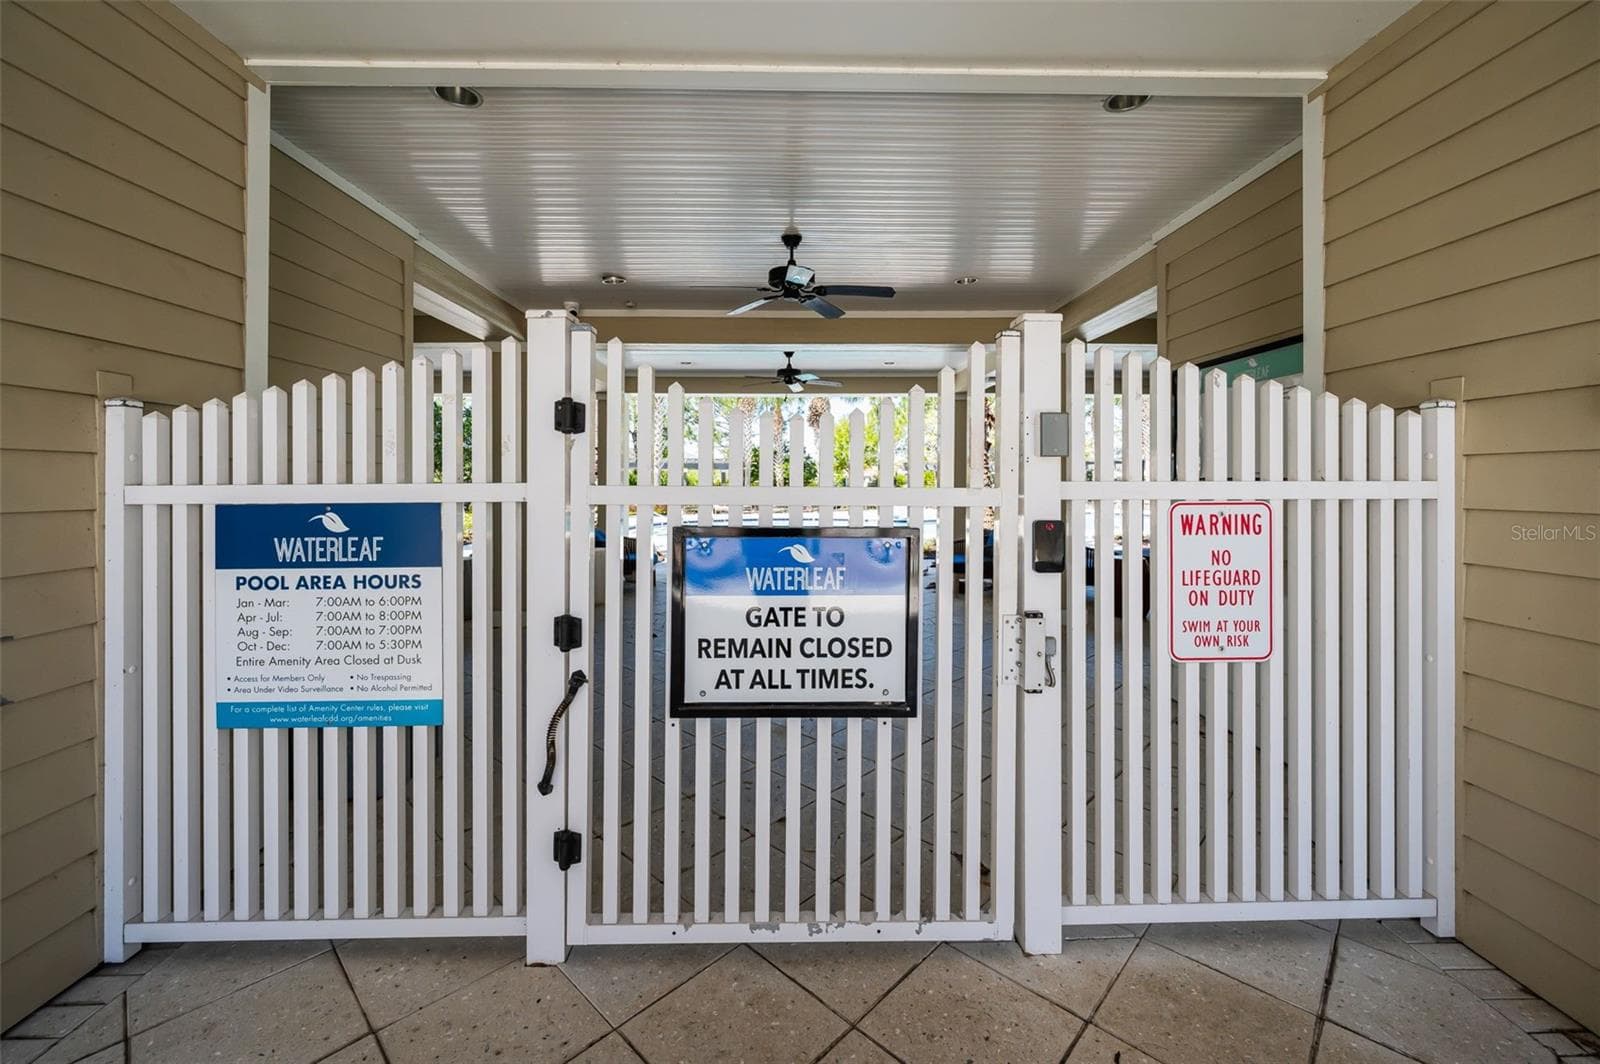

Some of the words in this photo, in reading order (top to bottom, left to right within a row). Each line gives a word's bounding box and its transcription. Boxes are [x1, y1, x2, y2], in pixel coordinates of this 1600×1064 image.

[1181, 514, 1262, 535] WARNING
[274, 536, 384, 562] WATERLEAF
[1212, 550, 1231, 566] NO
[236, 576, 289, 591] POOL
[296, 575, 346, 590] AREA
[354, 574, 422, 589] HOURS
[746, 567, 846, 590] WATERLEAF
[1182, 570, 1261, 586] LIFEGUARD
[236, 599, 254, 609] Jan
[265, 598, 290, 608] Mar:
[316, 597, 362, 607] 7:00AM
[365, 597, 375, 606] to
[378, 596, 422, 606] 6:00PM
[1189, 590, 1208, 606] ON
[1219, 590, 1254, 606] DUTY
[237, 613, 256, 624] Apr
[266, 612, 283, 623] Jul:
[316, 612, 362, 621] 7:00AM
[365, 611, 375, 620] to
[378, 611, 422, 620] 8:00PM
[746, 607, 806, 628] GATE
[812, 607, 845, 627] TO
[237, 627, 259, 638] Aug
[269, 627, 292, 638] Sep:
[316, 626, 362, 636] 7:00AM
[365, 626, 375, 635] to
[378, 625, 422, 635] 7:00PM
[1183, 621, 1210, 632] SWIM
[1217, 621, 1228, 632] AT
[1234, 621, 1260, 632] YOUR
[237, 642, 257, 652] Oct
[267, 641, 290, 651] Dec:
[316, 641, 362, 650] 7:00AM
[365, 640, 375, 649] to
[378, 640, 422, 649] 5:30PM
[1195, 636, 1219, 647] OWN
[1227, 635, 1249, 646] RISK
[698, 638, 791, 659] REMAIN
[799, 637, 892, 658] CLOSED
[236, 657, 265, 667] Entire
[269, 656, 311, 668] Amenity
[315, 656, 340, 666] Area
[344, 655, 379, 665] Closed
[384, 656, 393, 665] at
[398, 654, 422, 664] Dusk
[308, 674, 325, 683] Only
[370, 674, 411, 682] Trespassing
[715, 669, 744, 689] AT
[750, 669, 791, 689] ALL
[797, 668, 874, 689] TIMES.
[234, 686, 251, 694] Area
[301, 685, 344, 693] Surveillance
[371, 684, 398, 692] Alcohol
[252, 706, 284, 714] complete
[309, 705, 338, 713] Amenity
[389, 704, 412, 712] please
